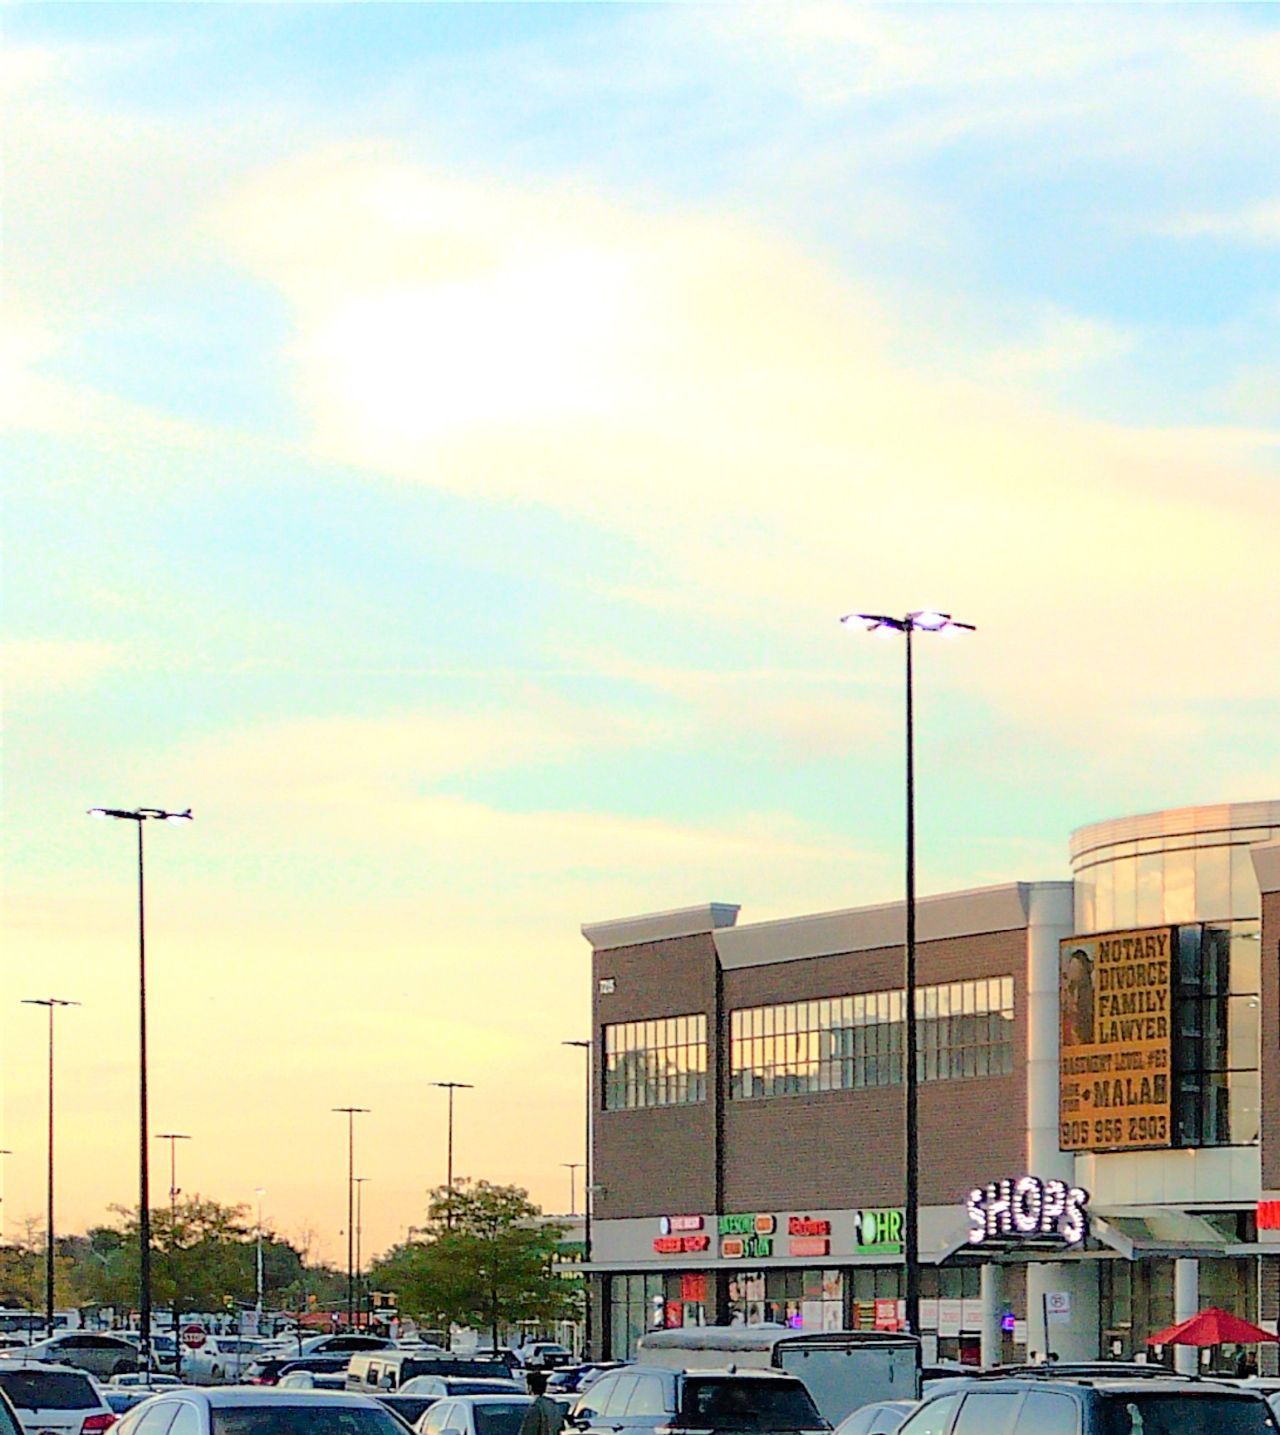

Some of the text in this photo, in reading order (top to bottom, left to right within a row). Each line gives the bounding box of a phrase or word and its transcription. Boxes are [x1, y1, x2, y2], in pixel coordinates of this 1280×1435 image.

[1099, 934, 1168, 963] NOTARY
[1099, 961, 1168, 992] DIVORCE
[1099, 989, 1168, 1018] FAMILY
[1099, 1016, 1168, 1044] LAWYER
[1062, 1120, 1089, 1145] 905
[1129, 1115, 1167, 1141] 2903
[966, 1175, 1086, 1244] SHOPS
